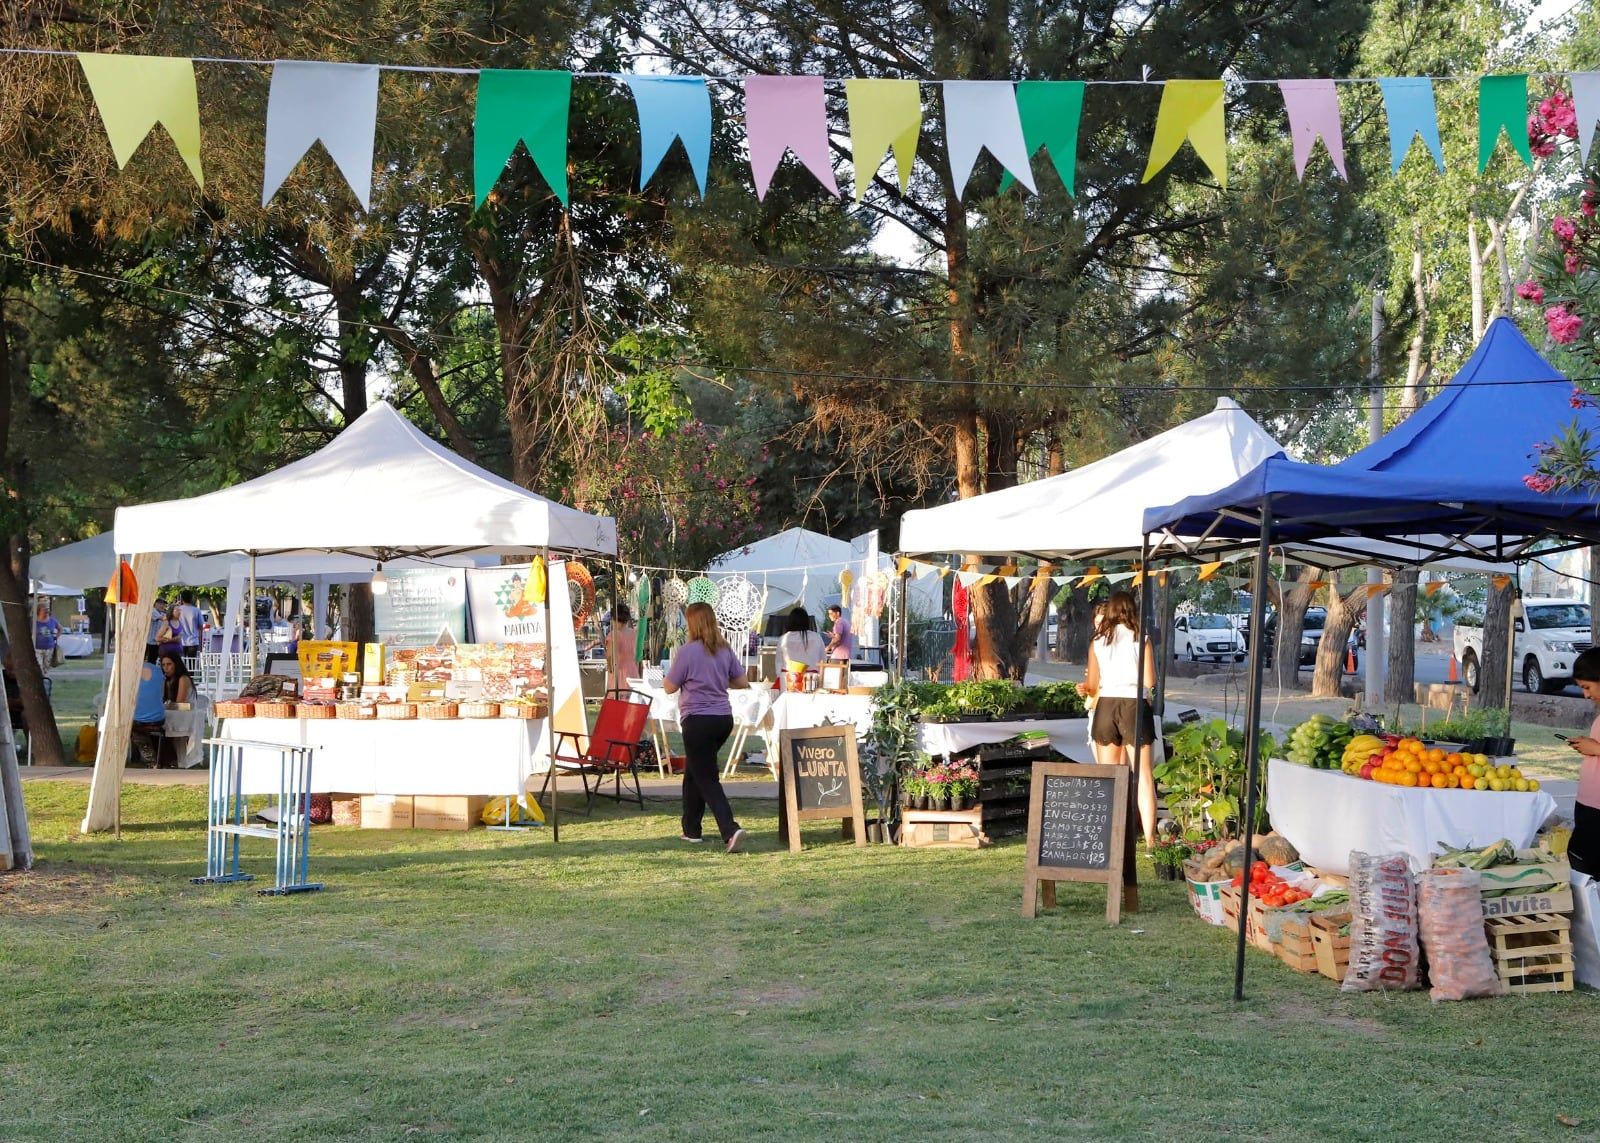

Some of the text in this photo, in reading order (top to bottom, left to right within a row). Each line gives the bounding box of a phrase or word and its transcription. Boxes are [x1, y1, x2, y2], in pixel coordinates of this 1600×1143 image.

[797, 745, 835, 760] Vivero
[797, 761, 847, 777] LUNTA
[1043, 822, 1083, 832] CAMOTE
[1480, 895, 1553, 916] Salvita
[1380, 857, 1411, 982] DON JULIO
